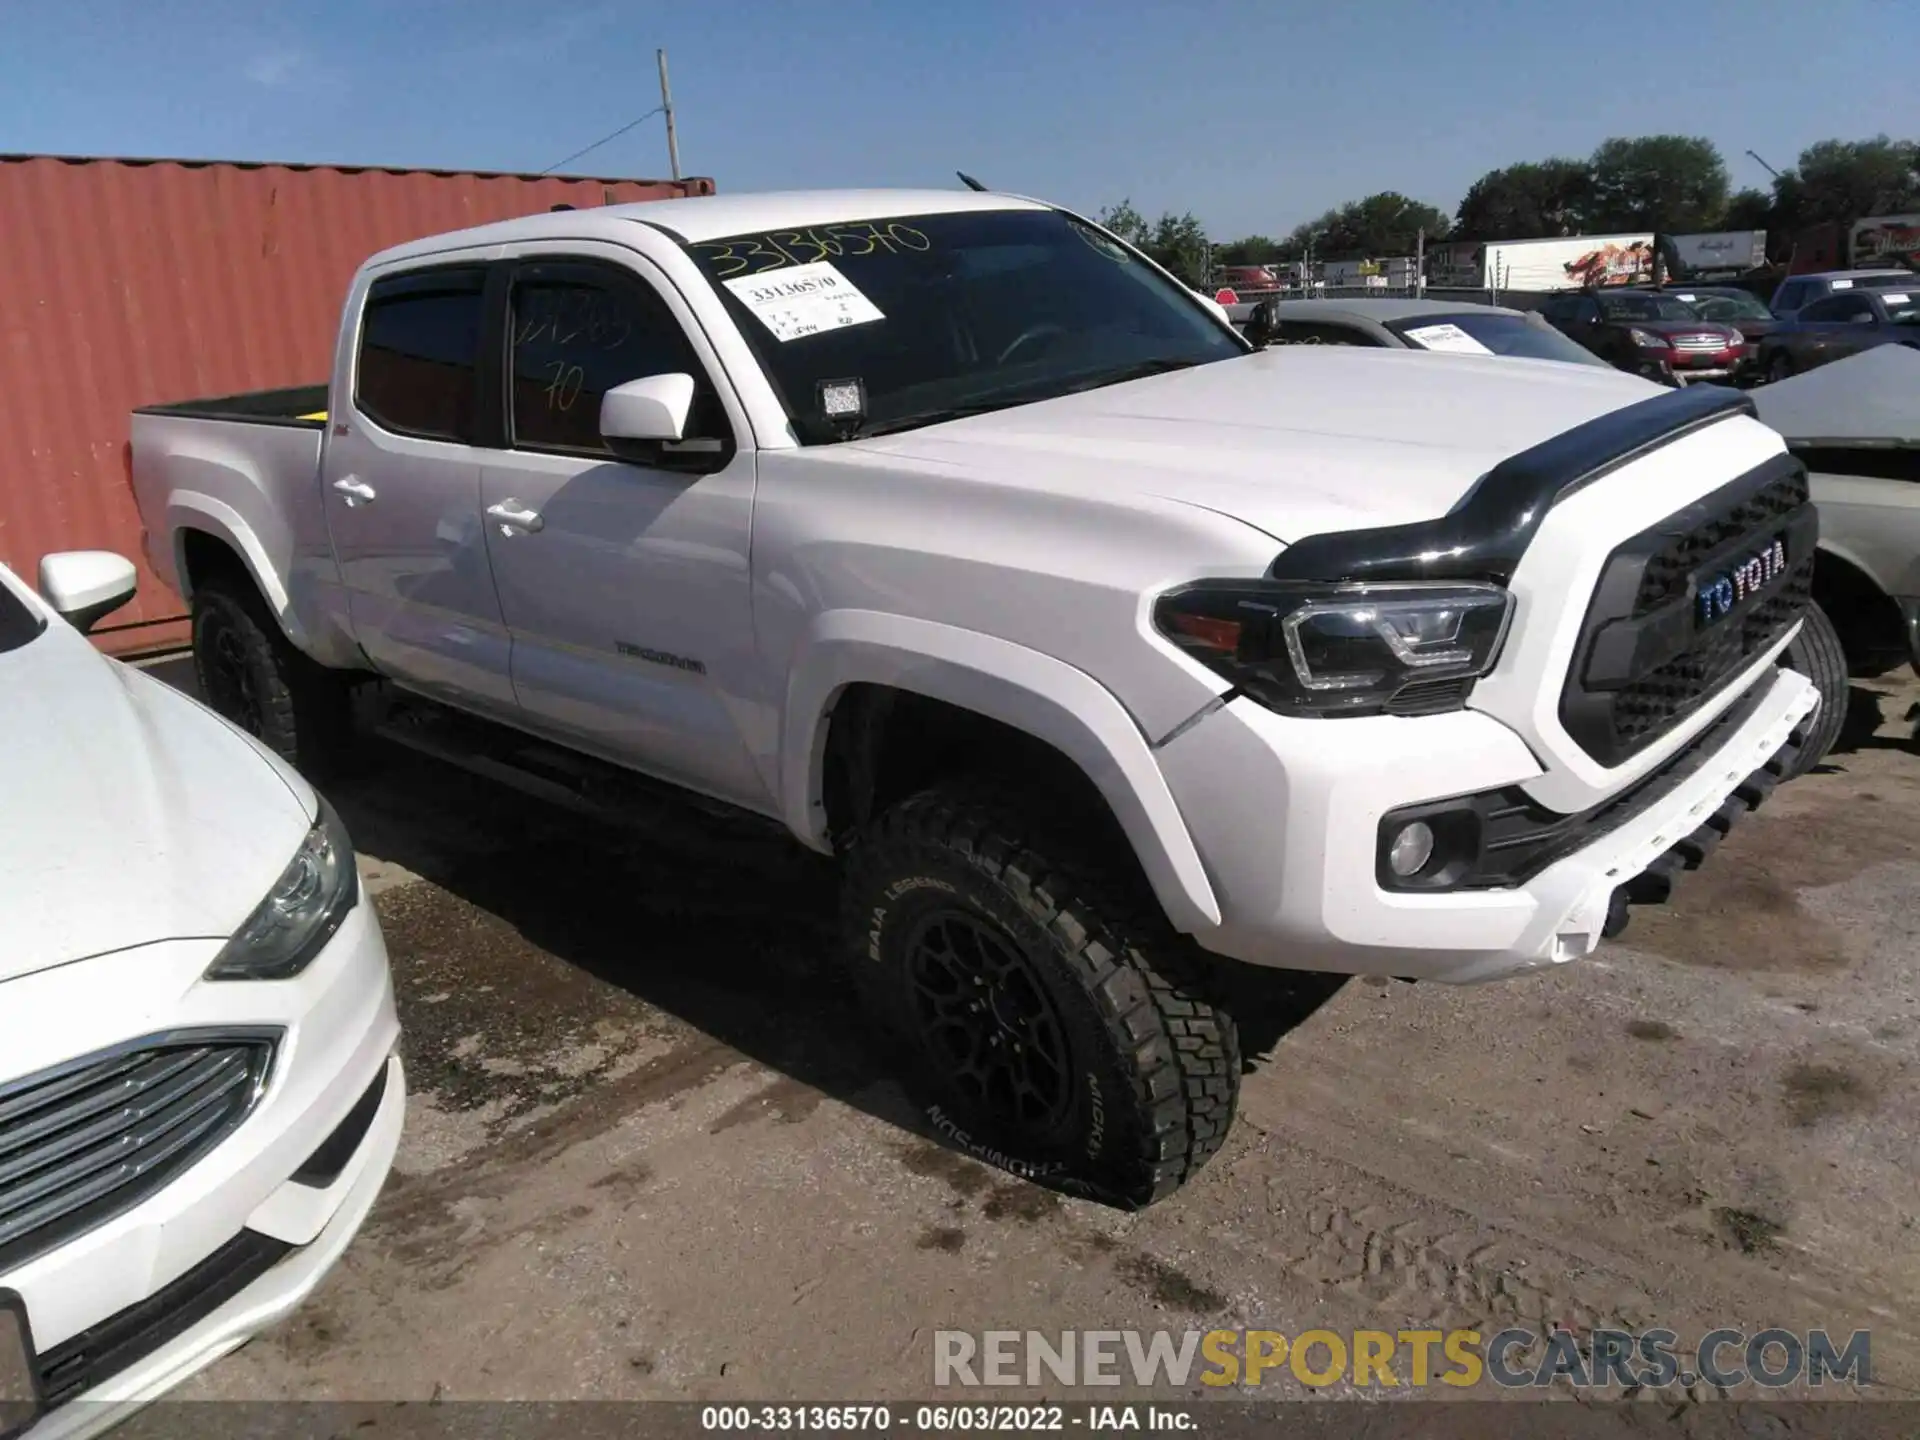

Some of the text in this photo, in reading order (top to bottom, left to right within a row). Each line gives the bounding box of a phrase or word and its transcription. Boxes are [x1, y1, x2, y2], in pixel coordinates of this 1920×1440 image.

[693, 223, 931, 277] 33136570
[751, 275, 837, 302] 33136570
[543, 359, 584, 411] 70
[1699, 540, 1785, 619] TOYOTA
[868, 874, 956, 963] BAJA LEGEND
